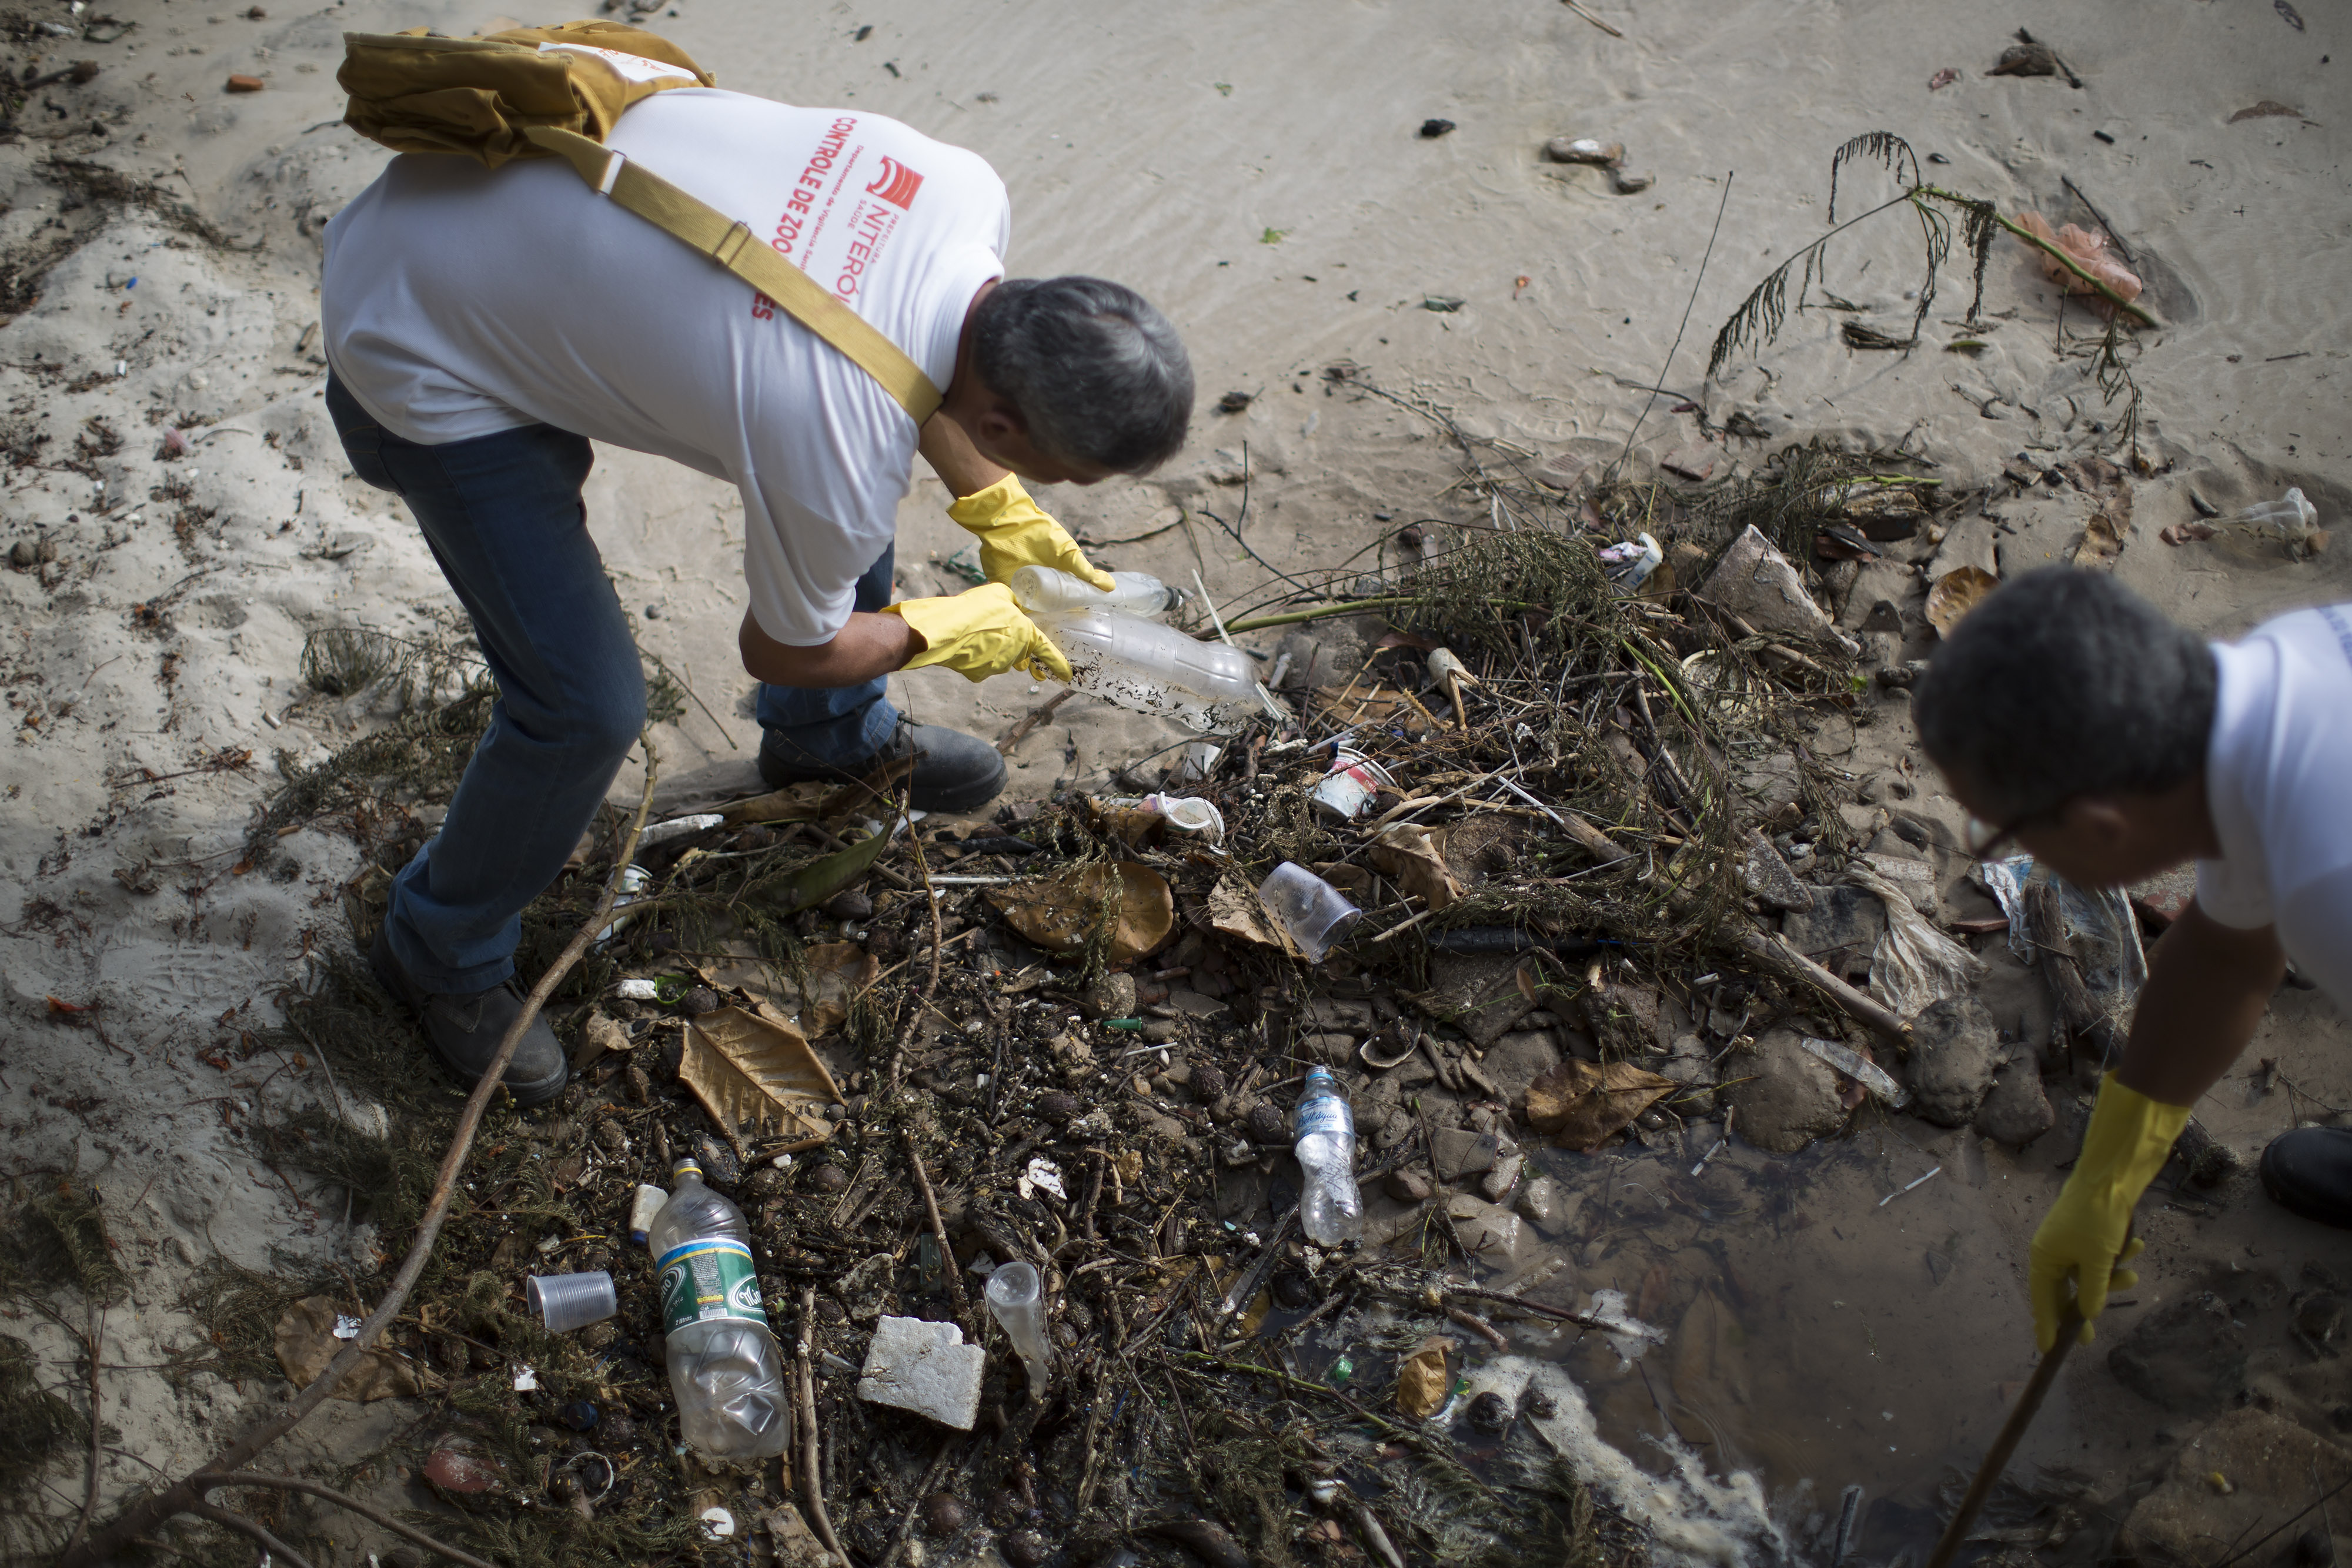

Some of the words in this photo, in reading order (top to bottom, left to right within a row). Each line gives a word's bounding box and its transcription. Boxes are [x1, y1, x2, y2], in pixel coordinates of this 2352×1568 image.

[799, 117, 858, 190] CONTROLE
[831, 145, 864, 195] Departamento
[787, 188, 816, 215] DE
[826, 196, 834, 206] de
[871, 213, 899, 263] PREFEITURA
[800, 249, 813, 270] Sanit
[679, 1315, 693, 1325] litros
